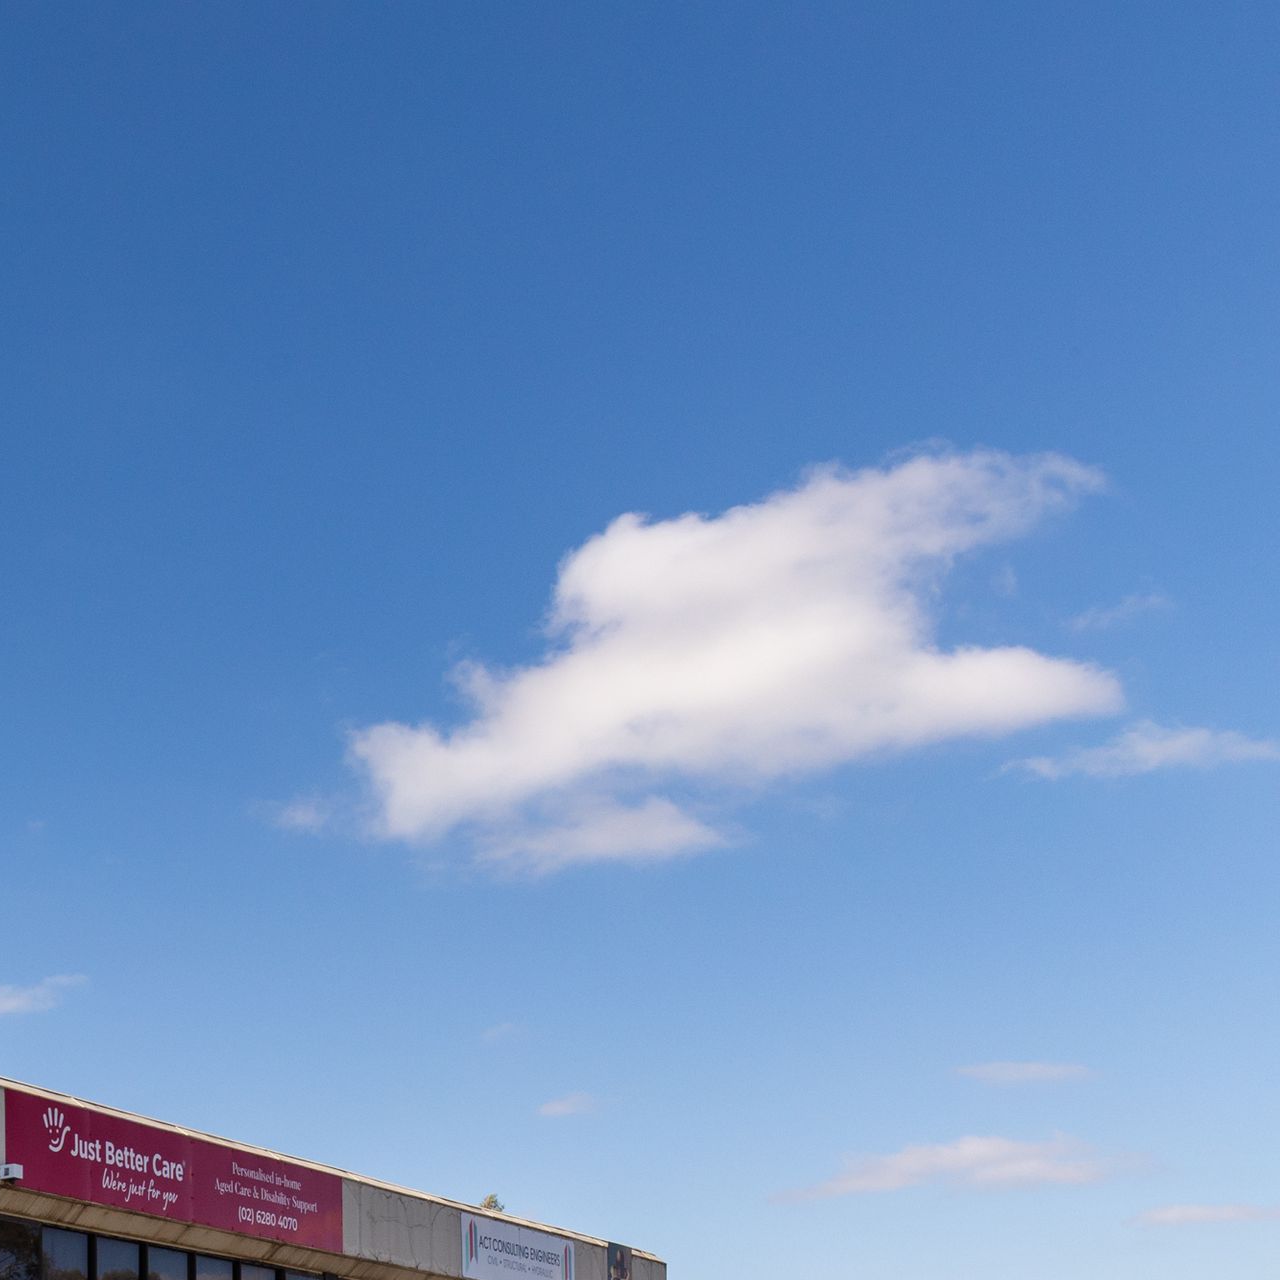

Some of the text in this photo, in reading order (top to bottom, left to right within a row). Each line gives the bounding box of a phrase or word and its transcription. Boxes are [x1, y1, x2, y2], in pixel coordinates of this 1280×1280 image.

[70, 1133, 184, 1182] Just Better Care
[102, 1167, 179, 1211] We're just for you
[232, 1161, 302, 1190] Personalised in-home
[214, 1178, 318, 1214] Aged Care & Disability Support
[238, 1205, 298, 1231] (02) 6280 4070
[479, 1235, 560, 1267] ACT CONSULTING ENGINEERS
